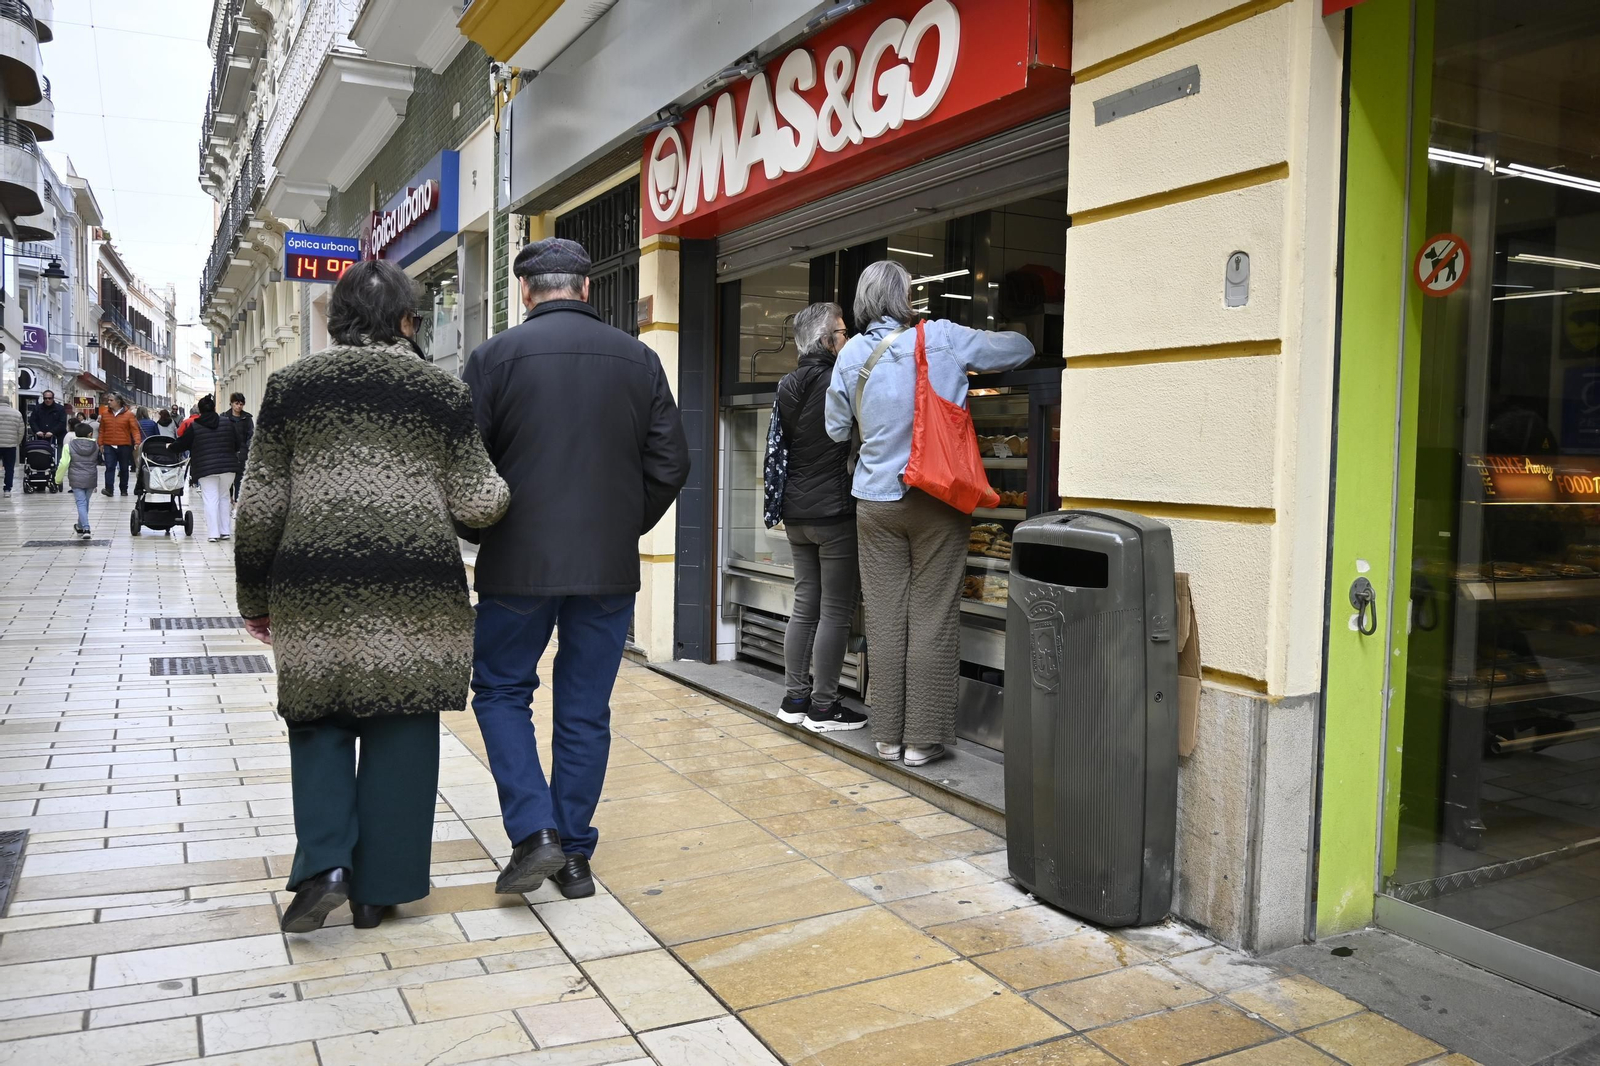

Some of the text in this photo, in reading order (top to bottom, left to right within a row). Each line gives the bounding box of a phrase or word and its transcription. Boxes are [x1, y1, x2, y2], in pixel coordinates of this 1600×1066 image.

[683, 0, 961, 215] MAS&GO
[371, 179, 432, 260] óptica urbano
[288, 237, 355, 253] óptica urbano
[1487, 457, 1554, 481] TAKE Away
[1555, 475, 1594, 494] FOOD
